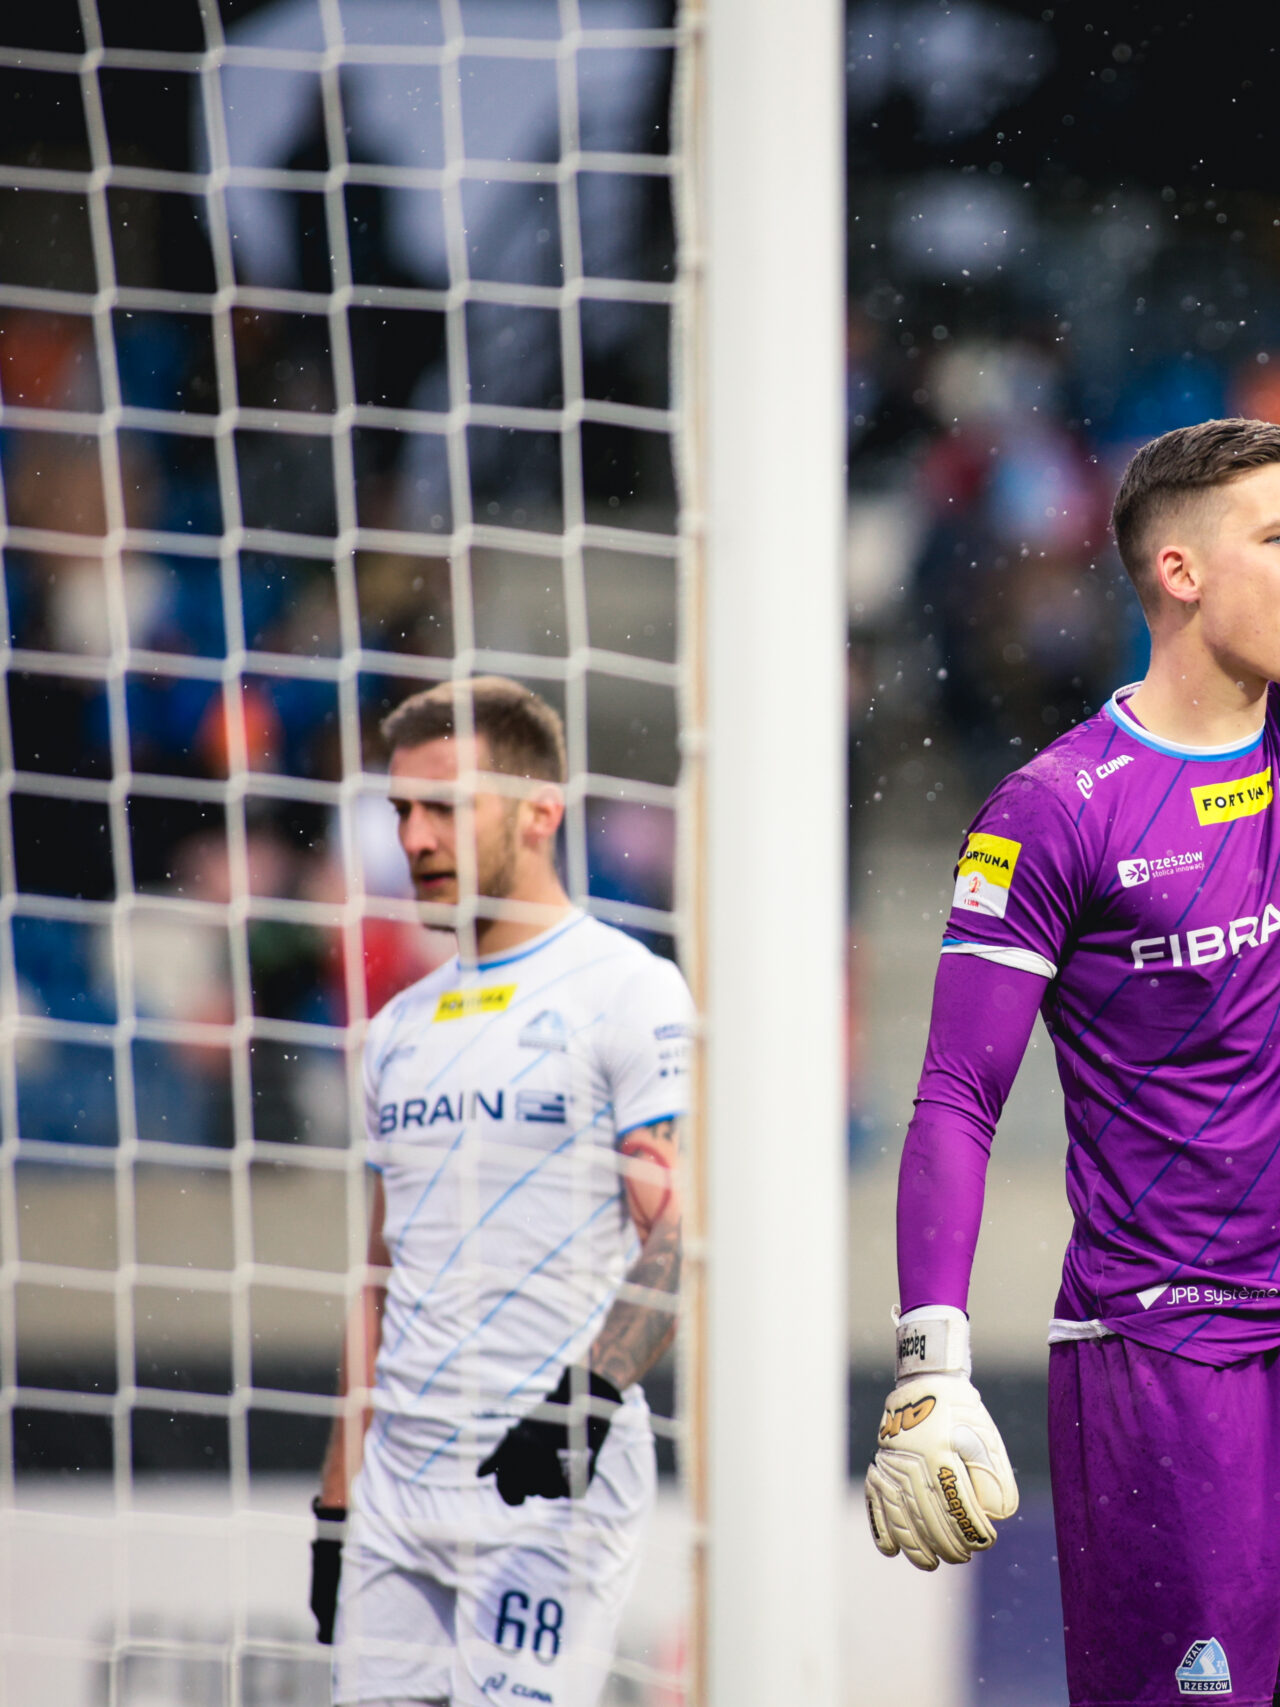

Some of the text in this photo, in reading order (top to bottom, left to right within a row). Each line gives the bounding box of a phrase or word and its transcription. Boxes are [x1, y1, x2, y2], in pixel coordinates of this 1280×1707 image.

[1096, 754, 1135, 779] CUNA
[966, 851, 1010, 870] ORTUNA
[1150, 851, 1203, 870] rzeszów
[1152, 868, 1174, 878] stolica
[1167, 1286, 1279, 1305] JPB système
[937, 1466, 981, 1543] 4keepers
[494, 1589, 564, 1667] 68
[1184, 1645, 1202, 1666] STAL
[1184, 1681, 1228, 1691] RZESZÓW
